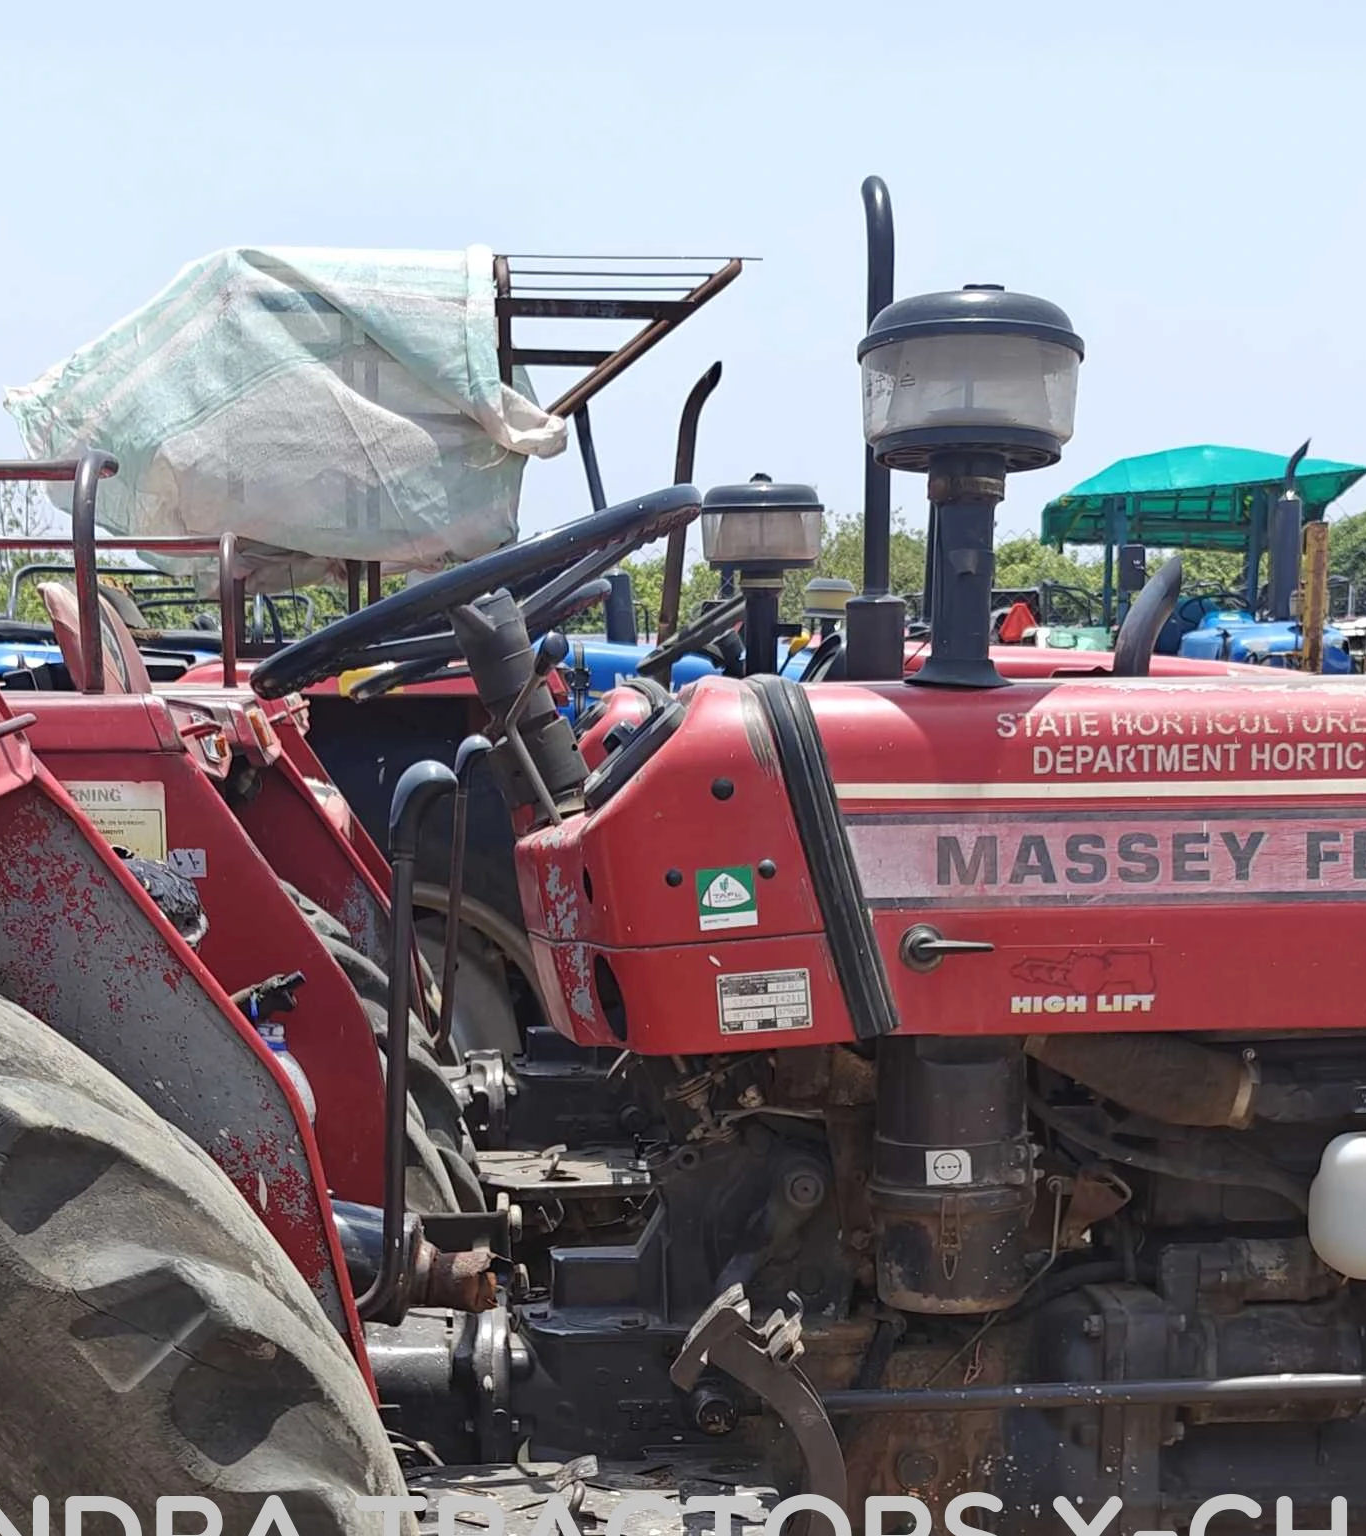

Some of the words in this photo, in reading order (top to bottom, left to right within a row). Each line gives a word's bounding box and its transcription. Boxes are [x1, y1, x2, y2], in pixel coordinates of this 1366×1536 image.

[996, 710, 1100, 738] STATE
[1033, 743, 1241, 774] DEPARTMENT
[936, 830, 1268, 885] MASSEY
[1010, 995, 1088, 1014] HIGH
[1097, 993, 1156, 1012] LIFT
